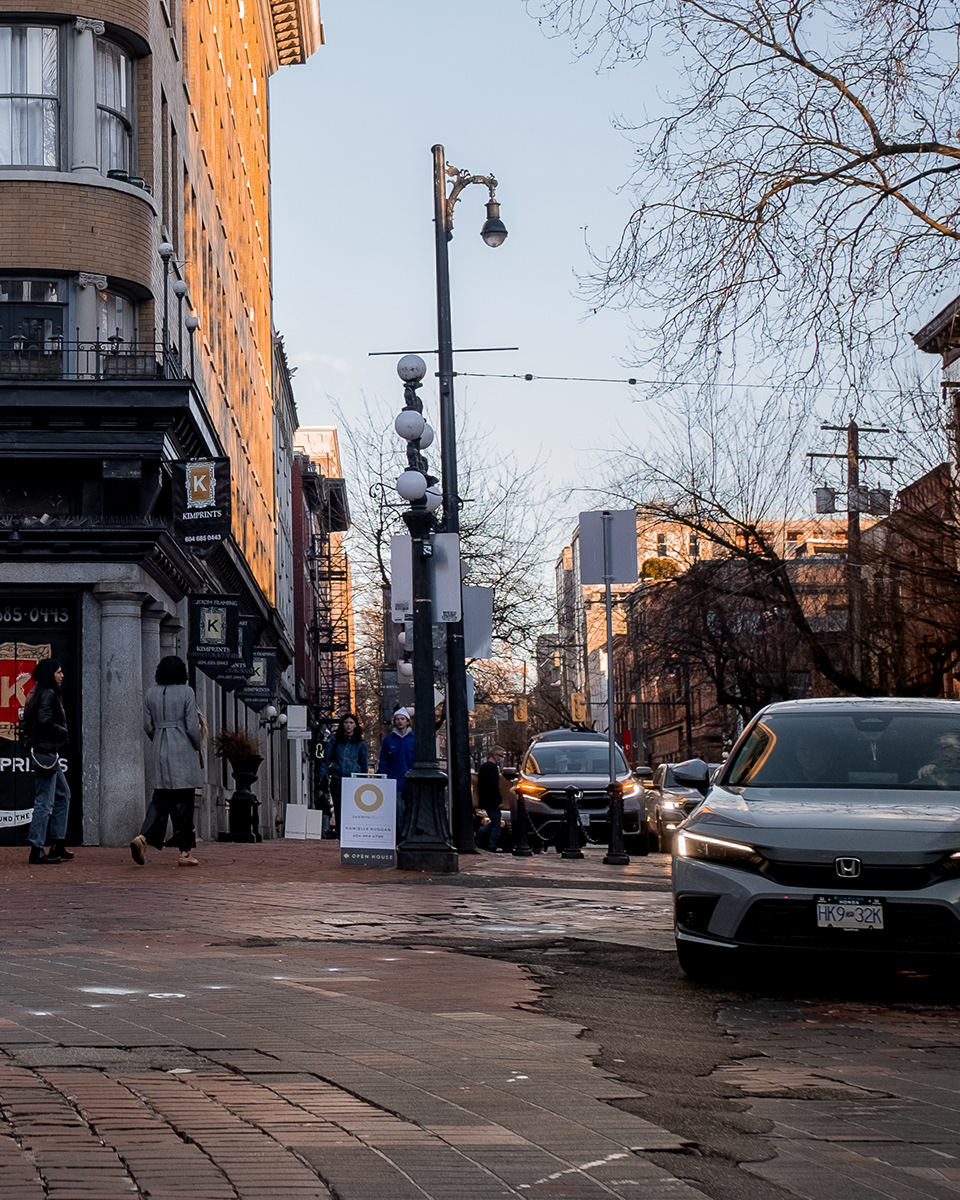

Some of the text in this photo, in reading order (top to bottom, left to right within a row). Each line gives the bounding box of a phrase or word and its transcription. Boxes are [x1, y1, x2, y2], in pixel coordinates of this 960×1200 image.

[193, 475, 207, 492] K
[182, 510, 222, 520] KIMPRINTS
[208, 620, 218, 632] K
[0, 672, 32, 708] K
[15, 812, 30, 820] THE
[818, 906, 882, 924] HK9 32K
